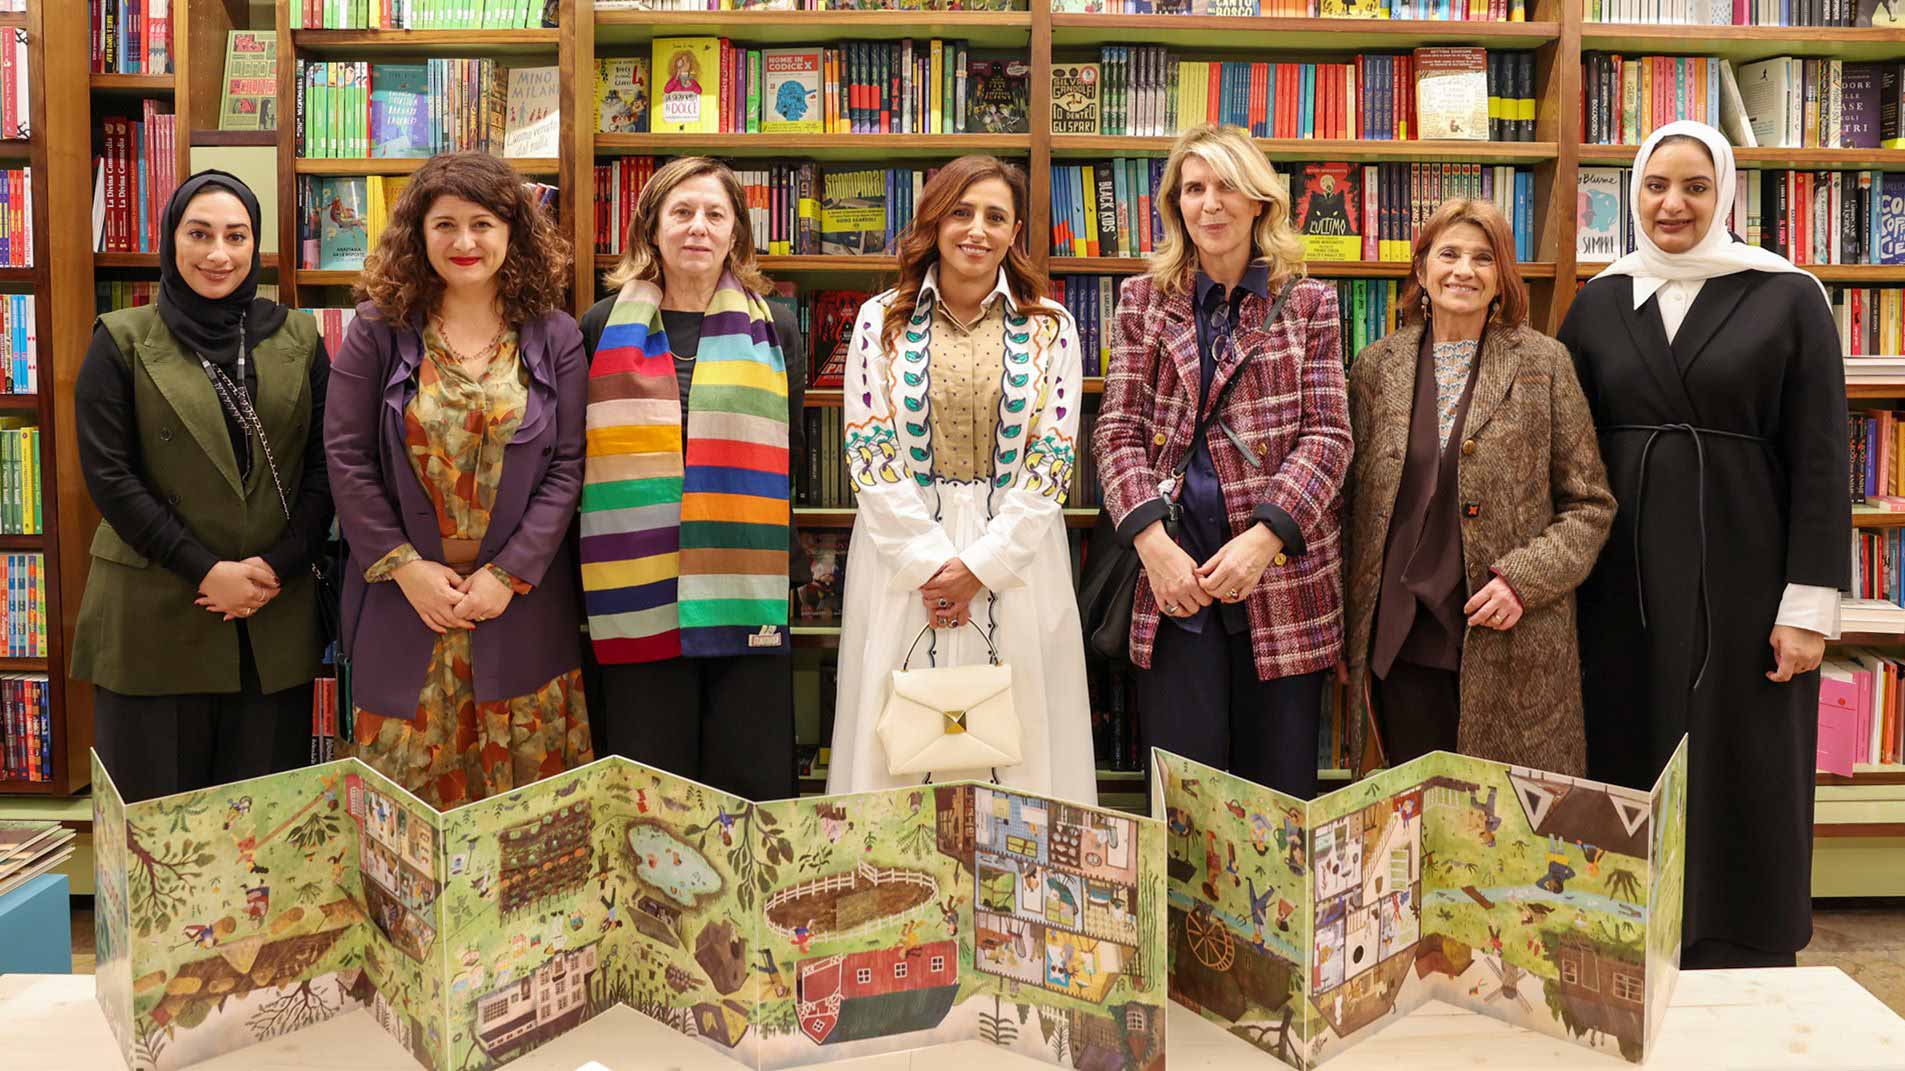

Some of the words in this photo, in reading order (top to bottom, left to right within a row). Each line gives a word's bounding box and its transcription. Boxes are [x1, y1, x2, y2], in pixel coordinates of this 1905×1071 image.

[1216, 7, 1253, 16] BOSCO
[768, 63, 803, 71] CODICE
[804, 61, 813, 70] X
[517, 71, 552, 85] MINO
[1053, 84, 1095, 99] GANDOLFI
[1066, 104, 1096, 120] DENTRO
[1053, 120, 1067, 132] GLI
[1068, 120, 1095, 132] SPARI
[105, 137, 113, 174] Commedia
[117, 137, 126, 174] Commedia
[106, 175, 114, 198] Divina
[118, 175, 126, 198] Divina
[1583, 173, 1618, 185] Blume
[1098, 181, 1116, 209] BLACK
[107, 199, 114, 208] La
[119, 199, 126, 208] La
[1100, 211, 1116, 233] KIDS
